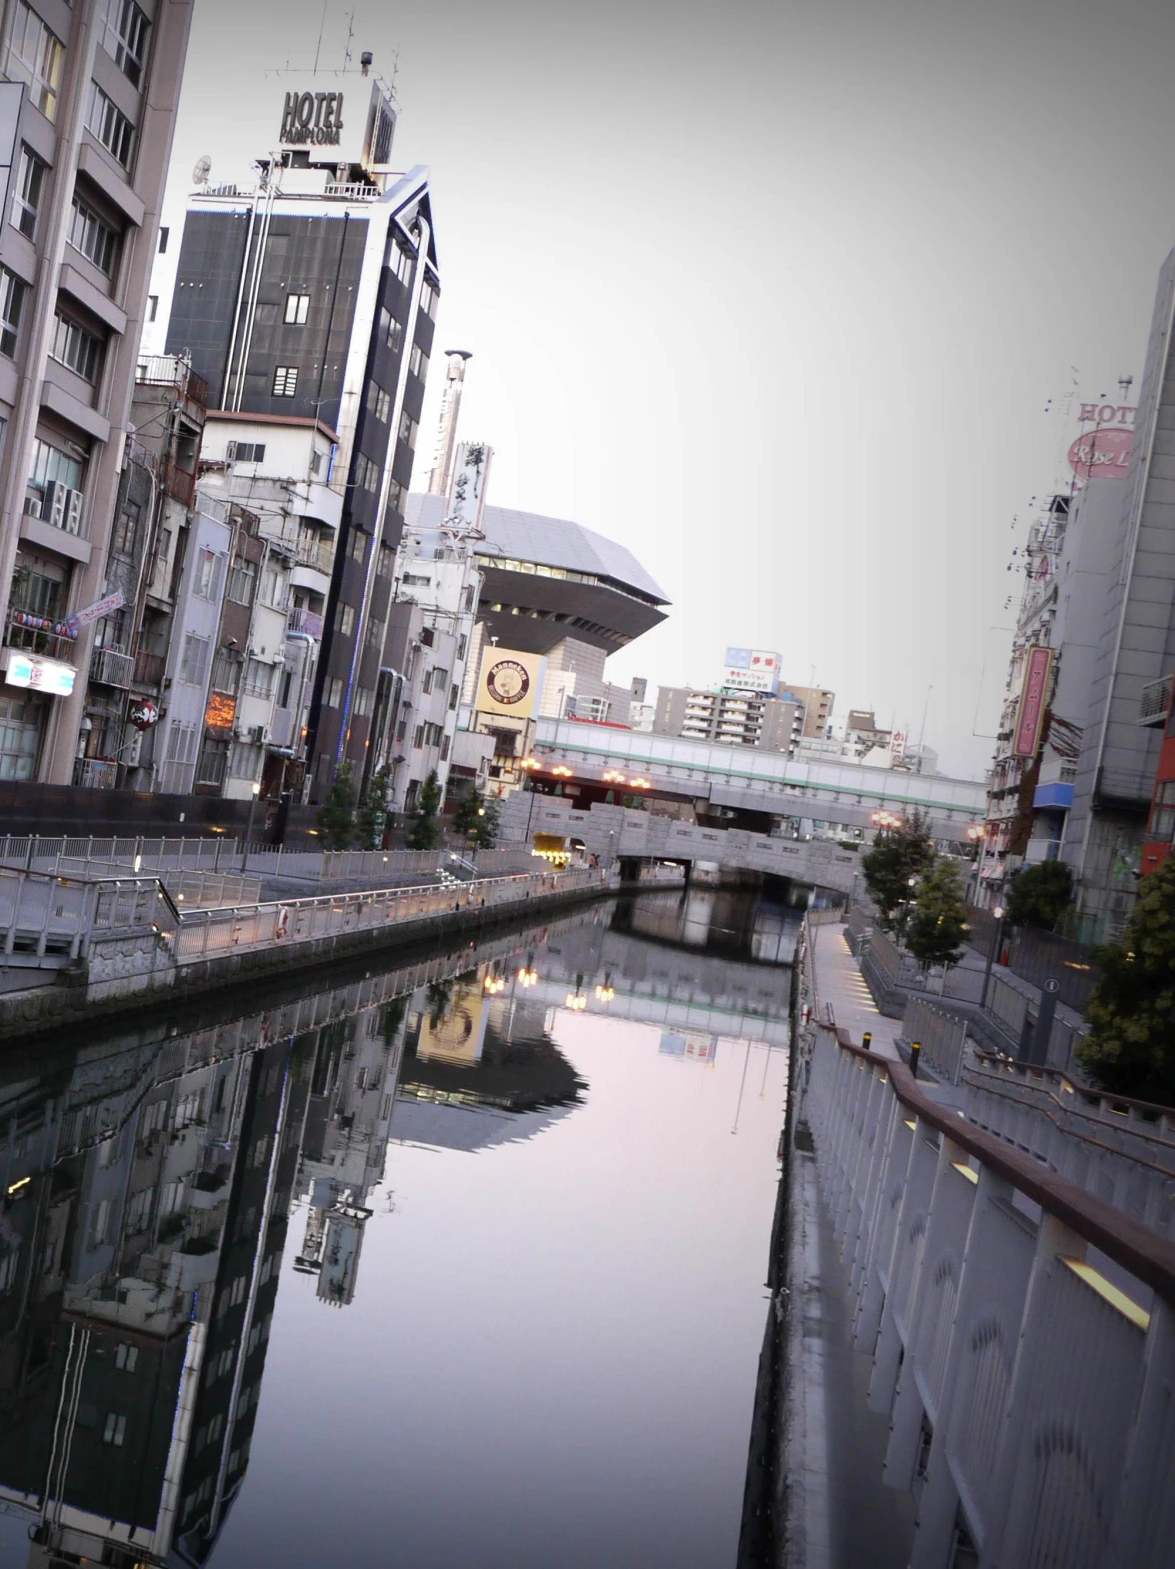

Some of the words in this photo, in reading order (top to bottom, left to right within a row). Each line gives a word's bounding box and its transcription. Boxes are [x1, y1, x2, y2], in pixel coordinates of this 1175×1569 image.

[281, 91, 343, 128] HOTEL
[279, 127, 340, 146] PAMPLONA
[1077, 403, 1138, 424] HOT
[491, 662, 527, 680] Manneken
